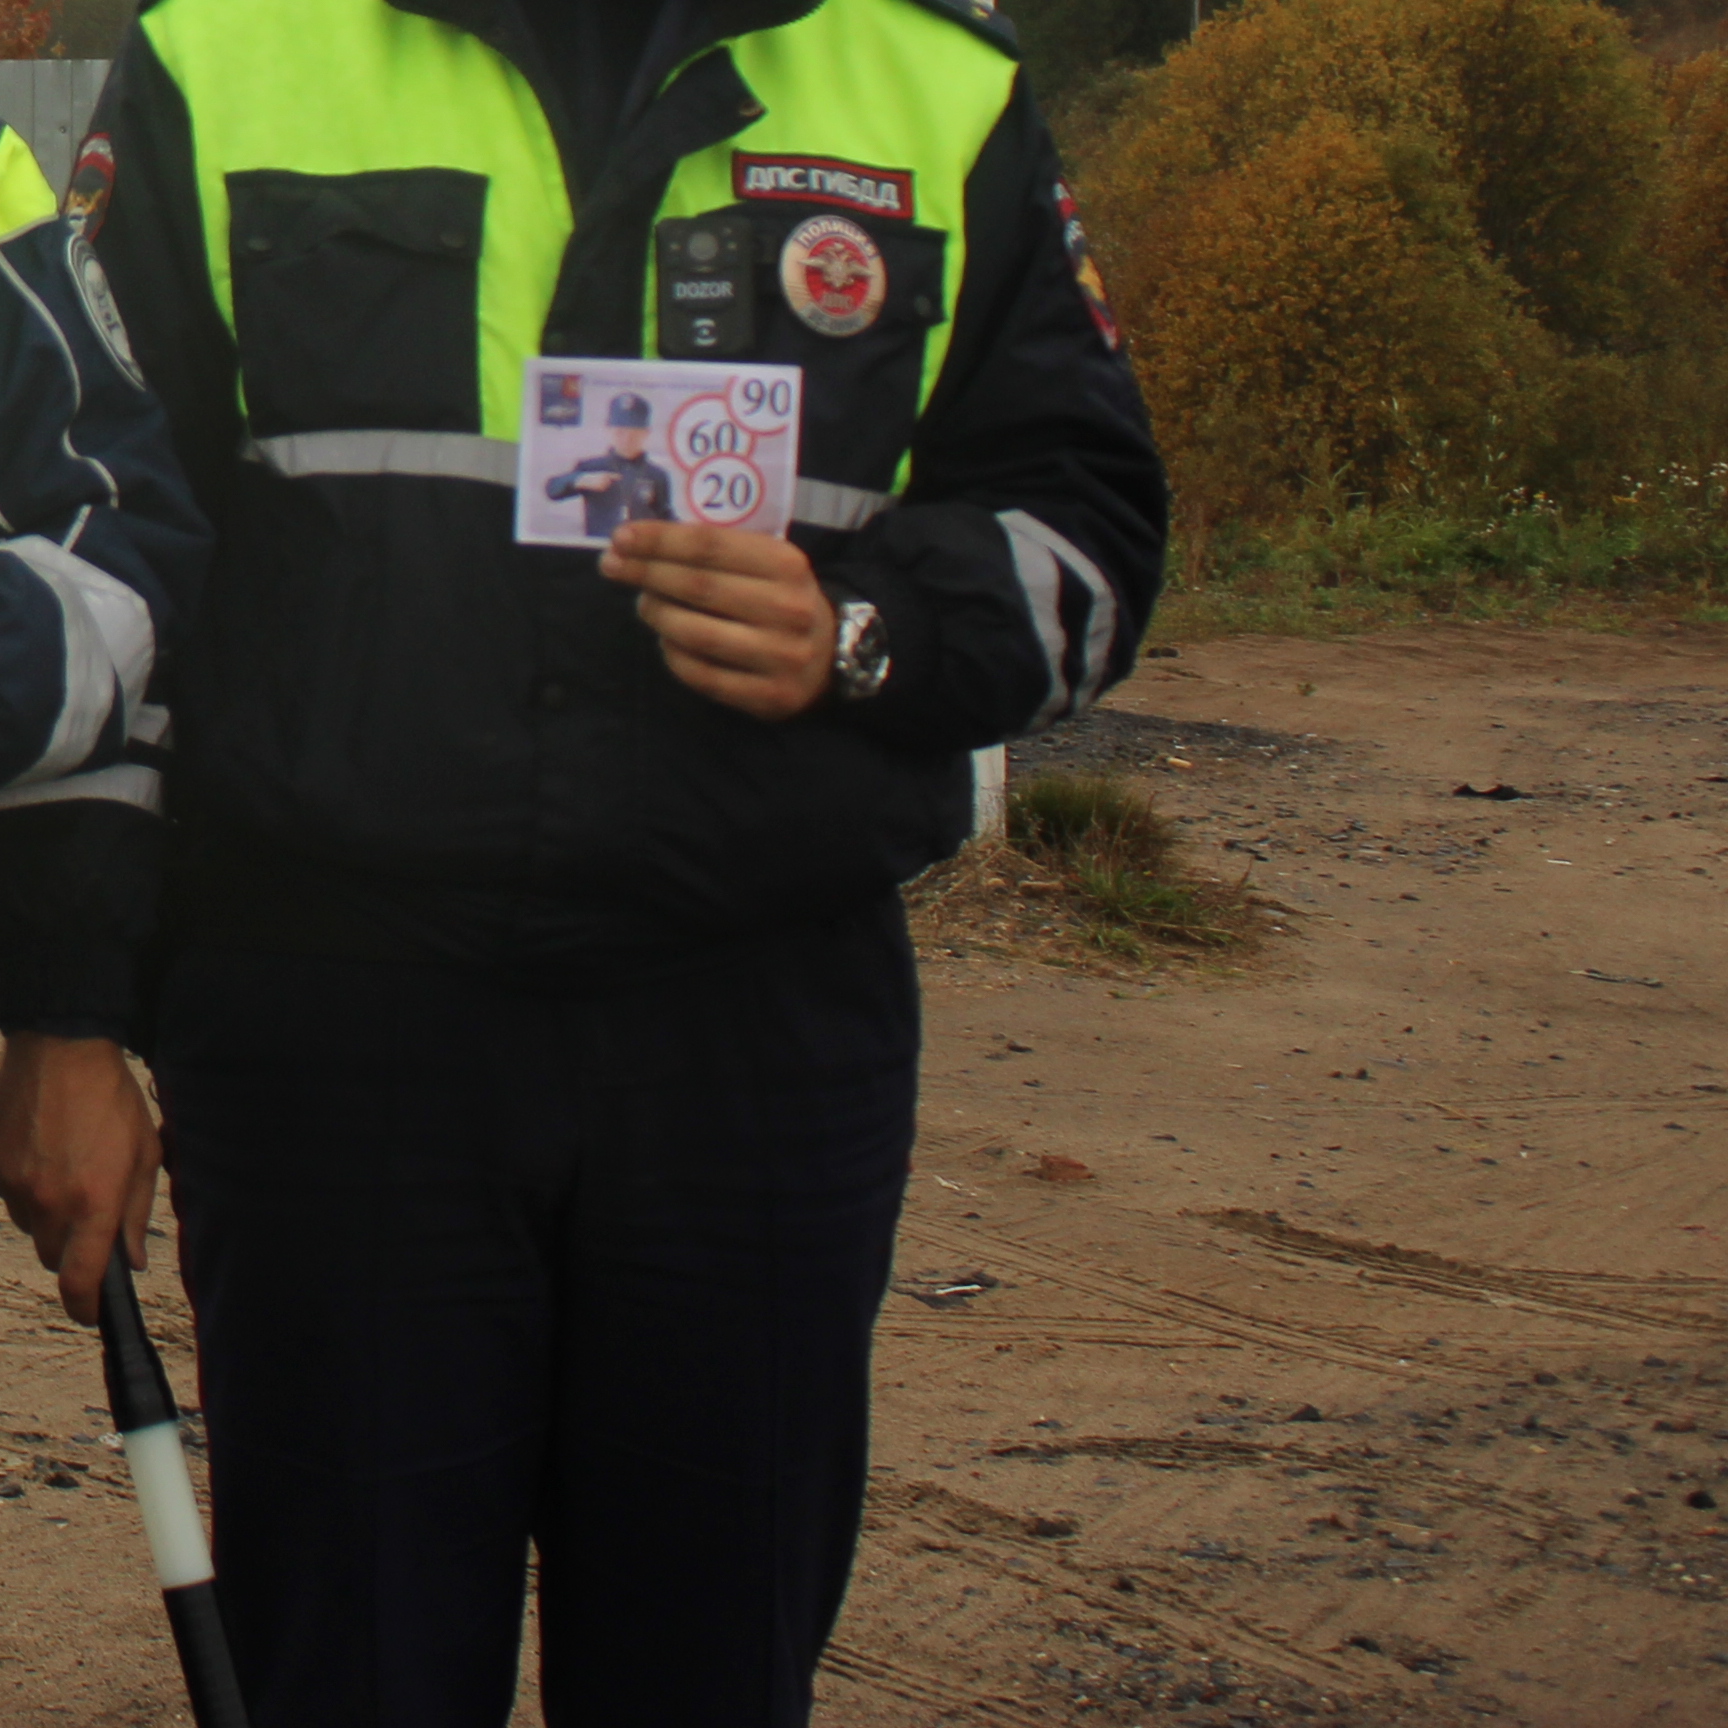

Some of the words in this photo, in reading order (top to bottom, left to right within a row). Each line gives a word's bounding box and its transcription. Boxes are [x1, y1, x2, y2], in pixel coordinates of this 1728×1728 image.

[746, 166, 806, 191] ДПС
[809, 168, 900, 210] ГИБДД
[673, 281, 733, 301] DOZOR
[743, 378, 792, 417] 90
[688, 421, 737, 457] 60
[703, 472, 753, 510] 20
